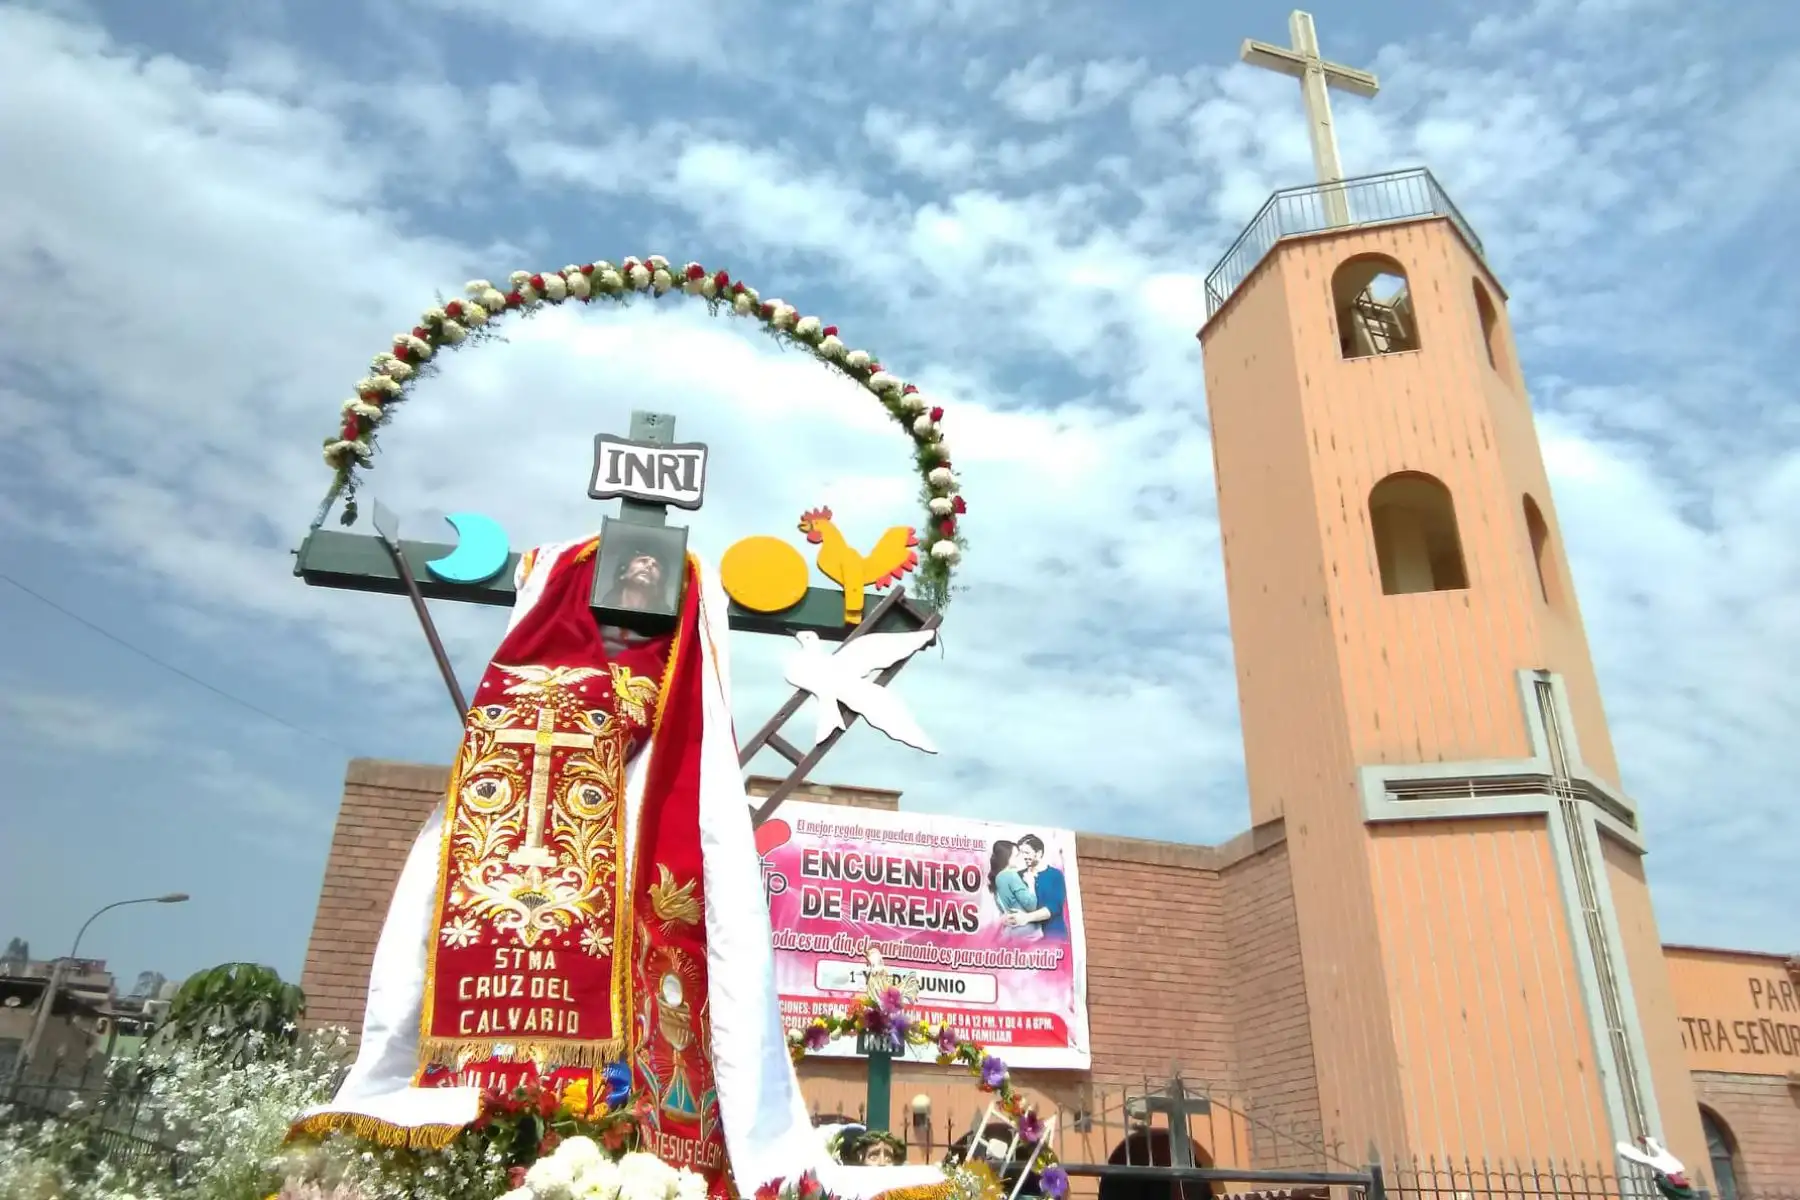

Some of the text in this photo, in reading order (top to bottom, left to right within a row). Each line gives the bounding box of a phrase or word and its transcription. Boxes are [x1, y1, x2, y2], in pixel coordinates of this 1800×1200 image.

[605, 449, 700, 492] INRI
[796, 819, 805, 831] El
[834, 824, 864, 839] regalo
[865, 828, 881, 841] que
[883, 829, 914, 843] pueden
[915, 830, 939, 845] darse
[940, 835, 950, 846] es
[951, 834, 971, 848] vivir
[802, 849, 982, 892] ENCUENTRO
[802, 887, 980, 933] DE PAREJAS
[495, 947, 557, 970] STMA
[799, 933, 814, 948] es
[815, 935, 830, 950] un
[832, 932, 856, 957] día,
[856, 936, 868, 955] el
[940, 949, 952, 962] es
[952, 949, 983, 968] para
[984, 947, 1013, 967] toda
[1014, 948, 1027, 967] la
[459, 974, 576, 1002] CRUZ DEL
[918, 976, 966, 994] JUNIO
[1748, 977, 1800, 1013] PAR
[459, 1007, 579, 1035] CALVARIO
[1677, 1016, 1734, 1053] TRA
